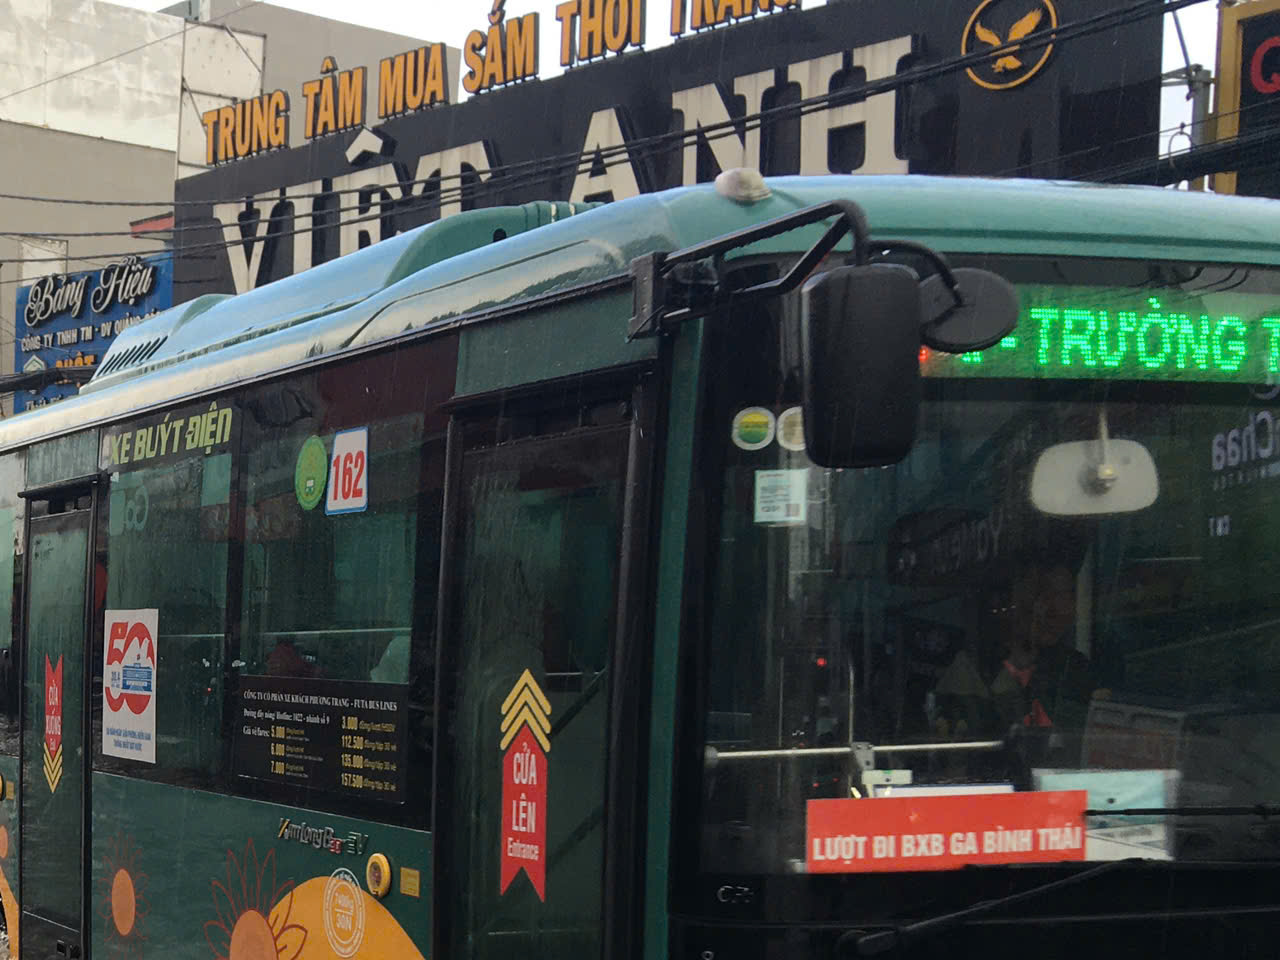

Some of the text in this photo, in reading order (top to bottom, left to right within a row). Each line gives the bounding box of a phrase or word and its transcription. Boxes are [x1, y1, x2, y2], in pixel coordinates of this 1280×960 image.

[202, 89, 288, 165] TRUNG
[303, 56, 366, 140] TÂM
[379, 43, 447, 119] MUA
[463, 0, 538, 94] SẮM
[570, 35, 912, 202] ANH
[24, 273, 88, 327] Bảng
[44, 333, 53, 347] TY
[1030, 297, 1247, 372] TRƯỜNG
[111, 401, 232, 465] XE BUÝT ĐIỆN
[333, 450, 366, 501] 162
[513, 742, 537, 785] CỬA
[512, 793, 536, 833] LÊN
[507, 837, 540, 861] Entrance
[812, 822, 1082, 864] LƯỢT ĐI BXB GA BÌNH THÁI
